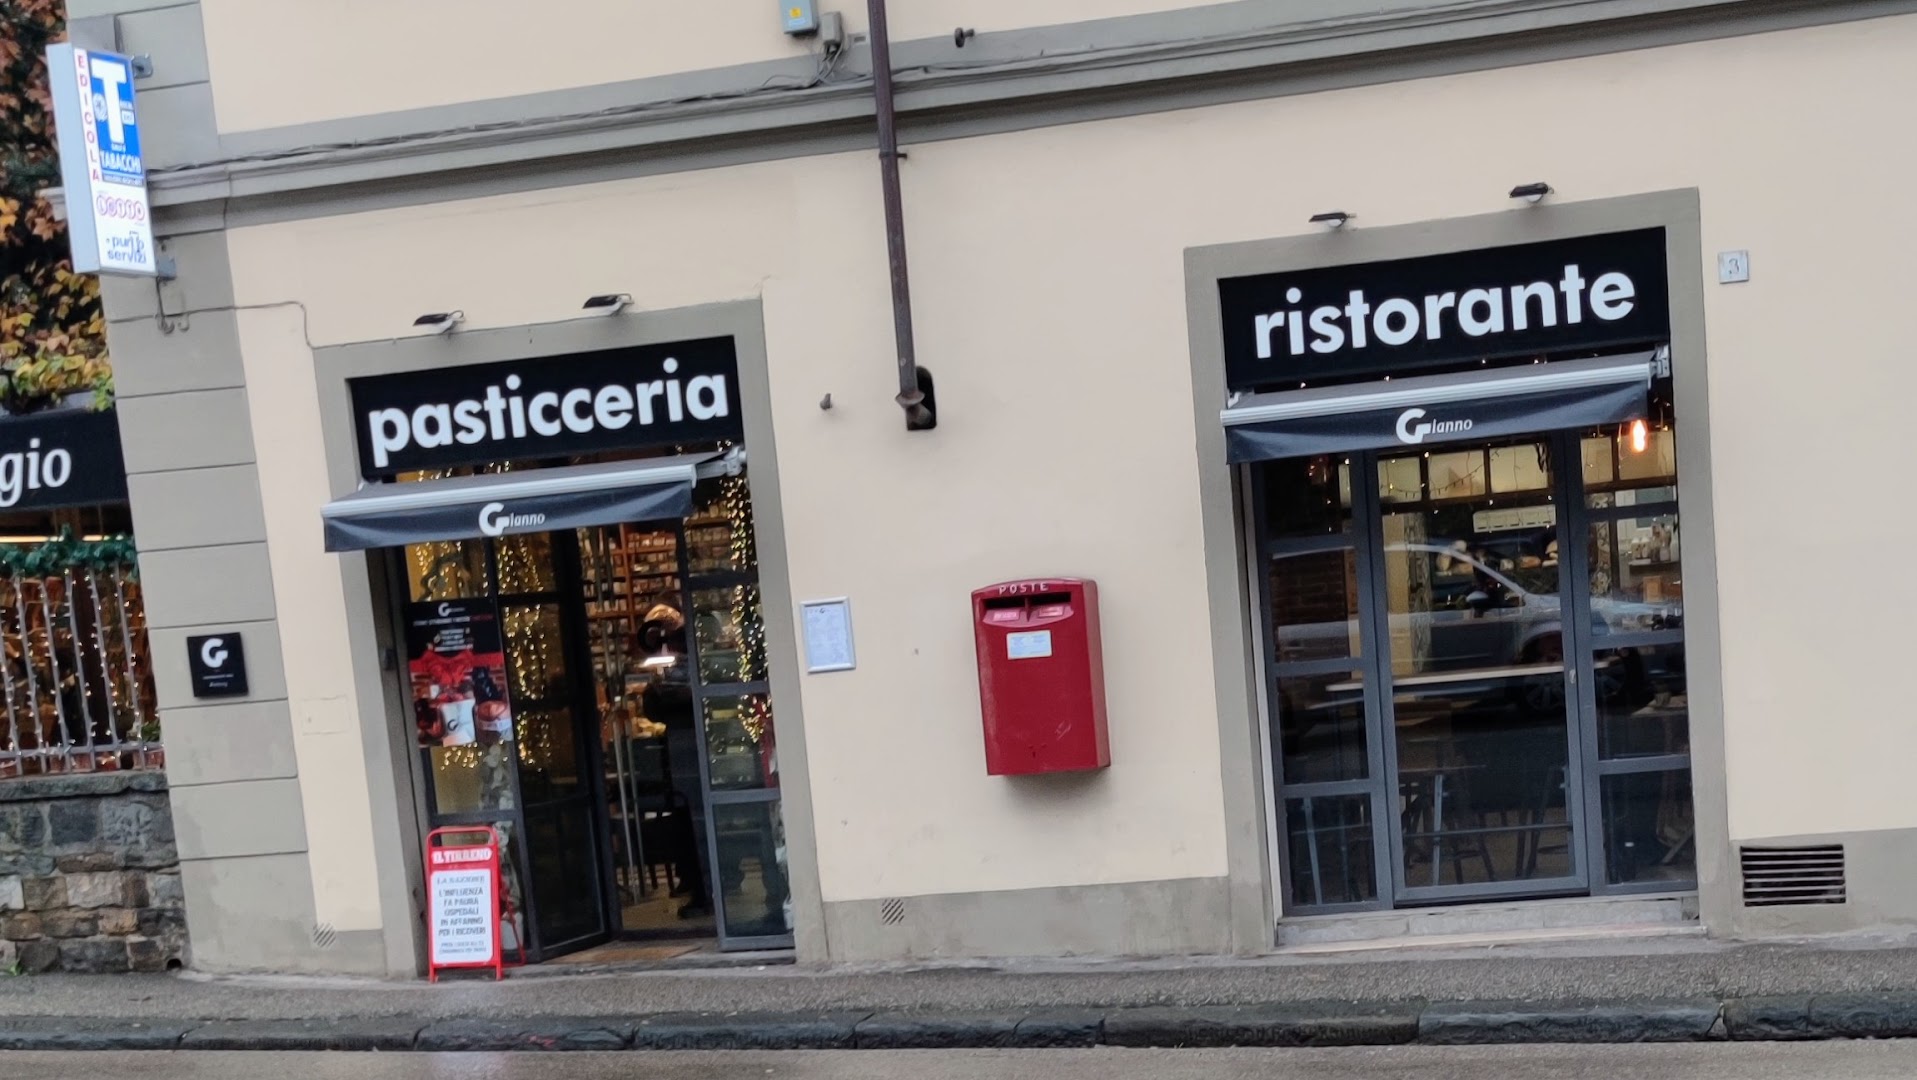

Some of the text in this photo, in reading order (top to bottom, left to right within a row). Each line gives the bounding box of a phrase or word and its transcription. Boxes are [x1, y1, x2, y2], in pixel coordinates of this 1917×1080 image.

[77, 54, 100, 182] EDICOLA
[100, 150, 142, 175] TABACCHI
[1253, 264, 1636, 359] ristorante
[368, 357, 730, 468] pasticceria
[999, 582, 1049, 595] POSTE
[444, 907, 479, 916] OSPEDALI
